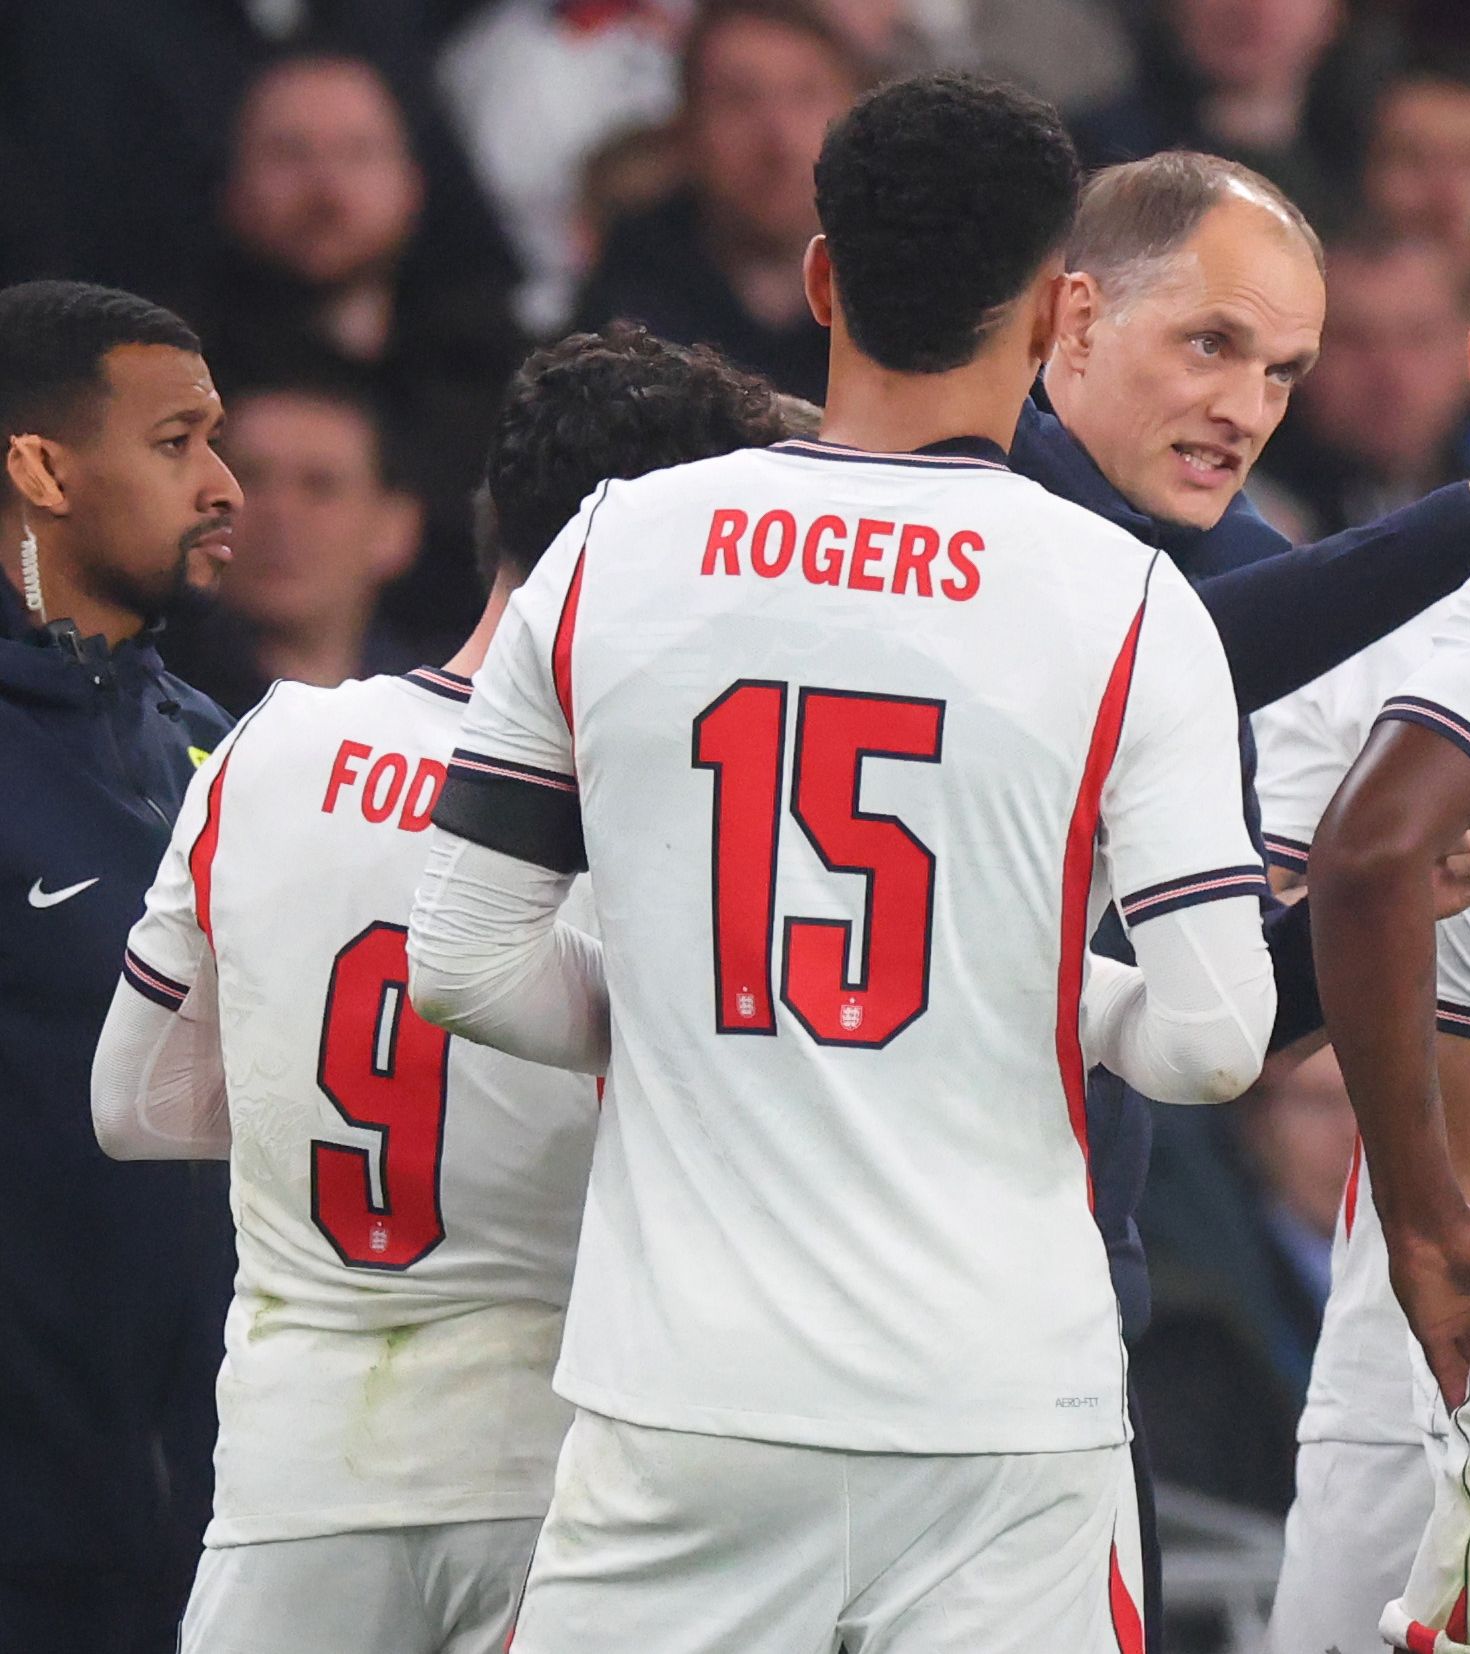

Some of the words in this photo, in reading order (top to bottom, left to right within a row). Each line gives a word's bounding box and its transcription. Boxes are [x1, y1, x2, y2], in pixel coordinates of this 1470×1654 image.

[701, 508, 986, 603] ROGERS
[321, 739, 449, 833] FOD
[691, 678, 946, 1050] 15
[310, 920, 449, 1272] 9
